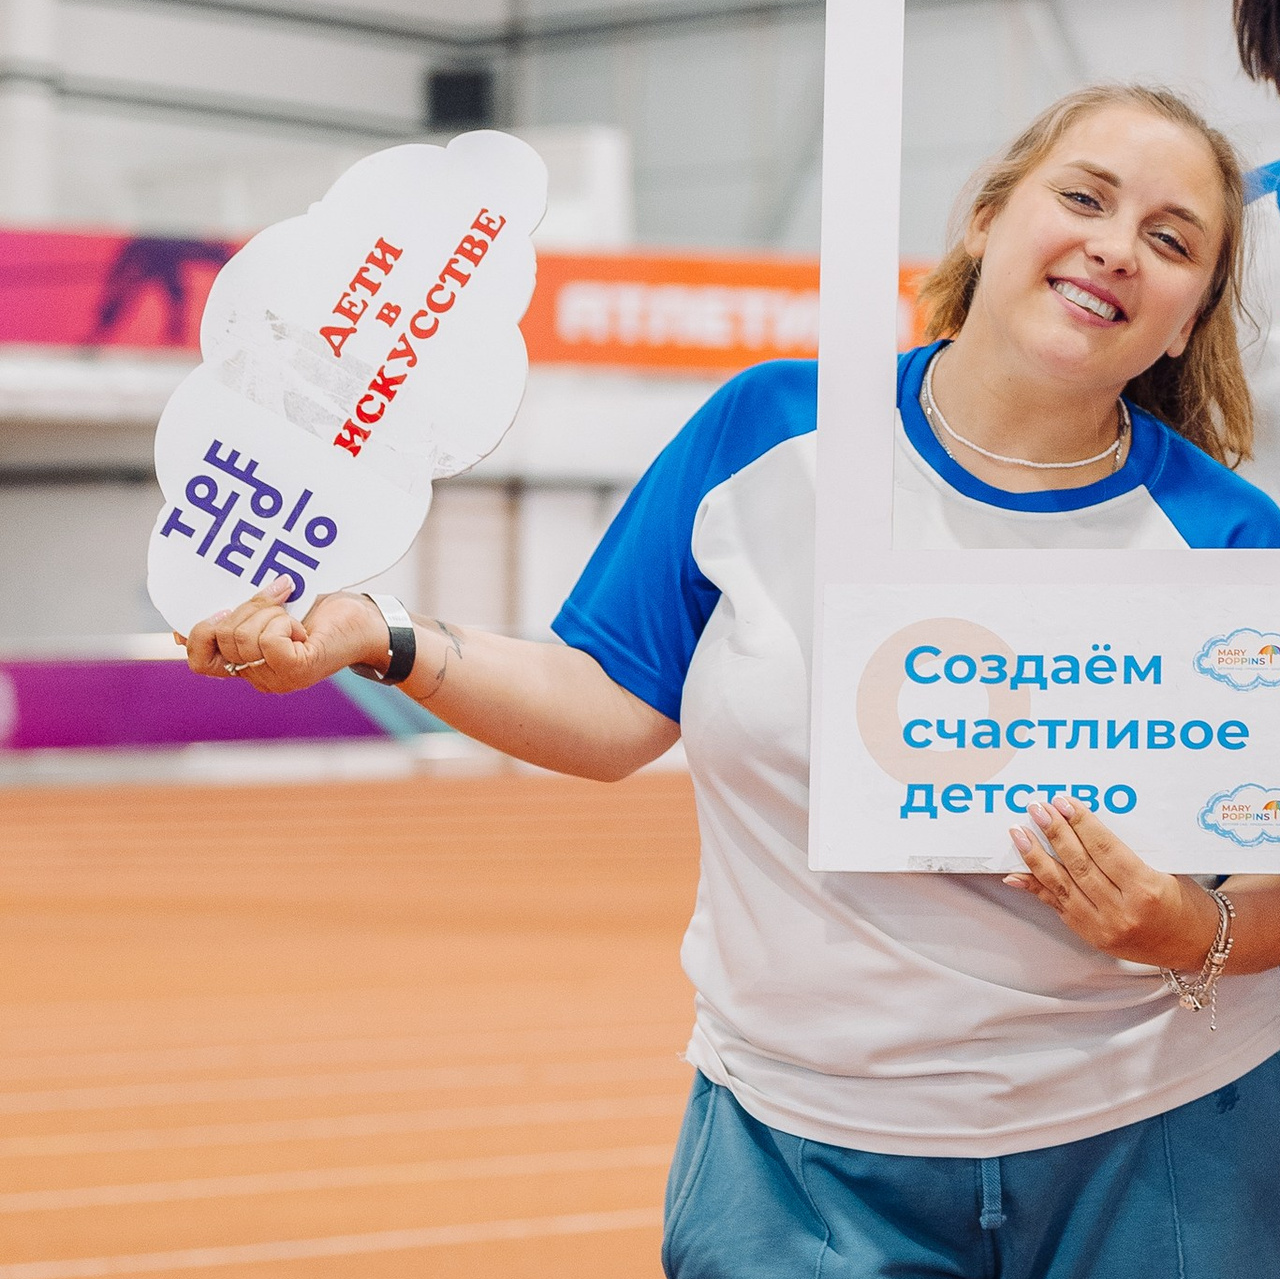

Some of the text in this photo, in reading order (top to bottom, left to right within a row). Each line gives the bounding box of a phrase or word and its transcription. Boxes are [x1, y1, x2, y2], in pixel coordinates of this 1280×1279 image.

[319, 237, 403, 358] ДЕТИ
[333, 208, 507, 458] ИСКУССТВЕ
[904, 642, 1163, 691] Создаём
[1217, 649, 1247, 657] MARY
[1217, 657, 1266, 666] POPPINS
[902, 717, 1250, 751] счастливое
[899, 782, 1138, 820] детство
[1221, 804, 1251, 812] MARY
[1221, 812, 1271, 821] POPPINS
